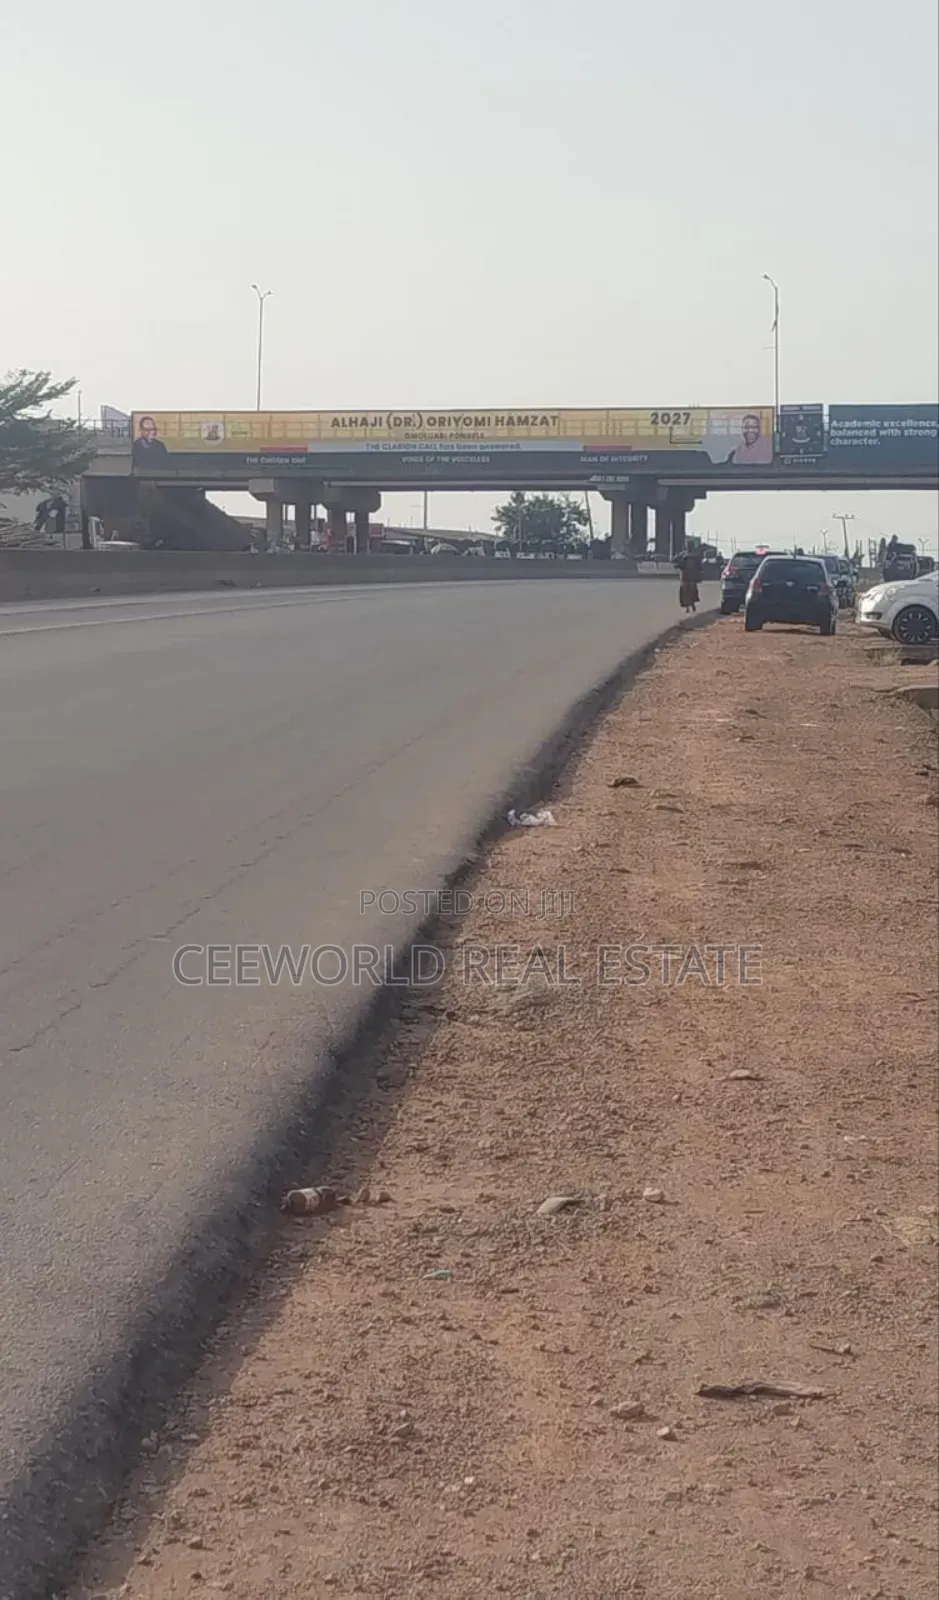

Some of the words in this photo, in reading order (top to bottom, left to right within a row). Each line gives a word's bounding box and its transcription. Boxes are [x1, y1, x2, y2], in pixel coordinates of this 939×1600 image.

[331, 416, 382, 428] ALHAJI
[426, 415, 491, 427] ORIYOMI
[495, 414, 558, 427] HAMZAT
[650, 412, 691, 425] 2027
[831, 420, 881, 428] Academic
[830, 428, 877, 437] balanced
[879, 428, 902, 437] with
[904, 428, 937, 438] strong
[830, 437, 881, 446] character.
